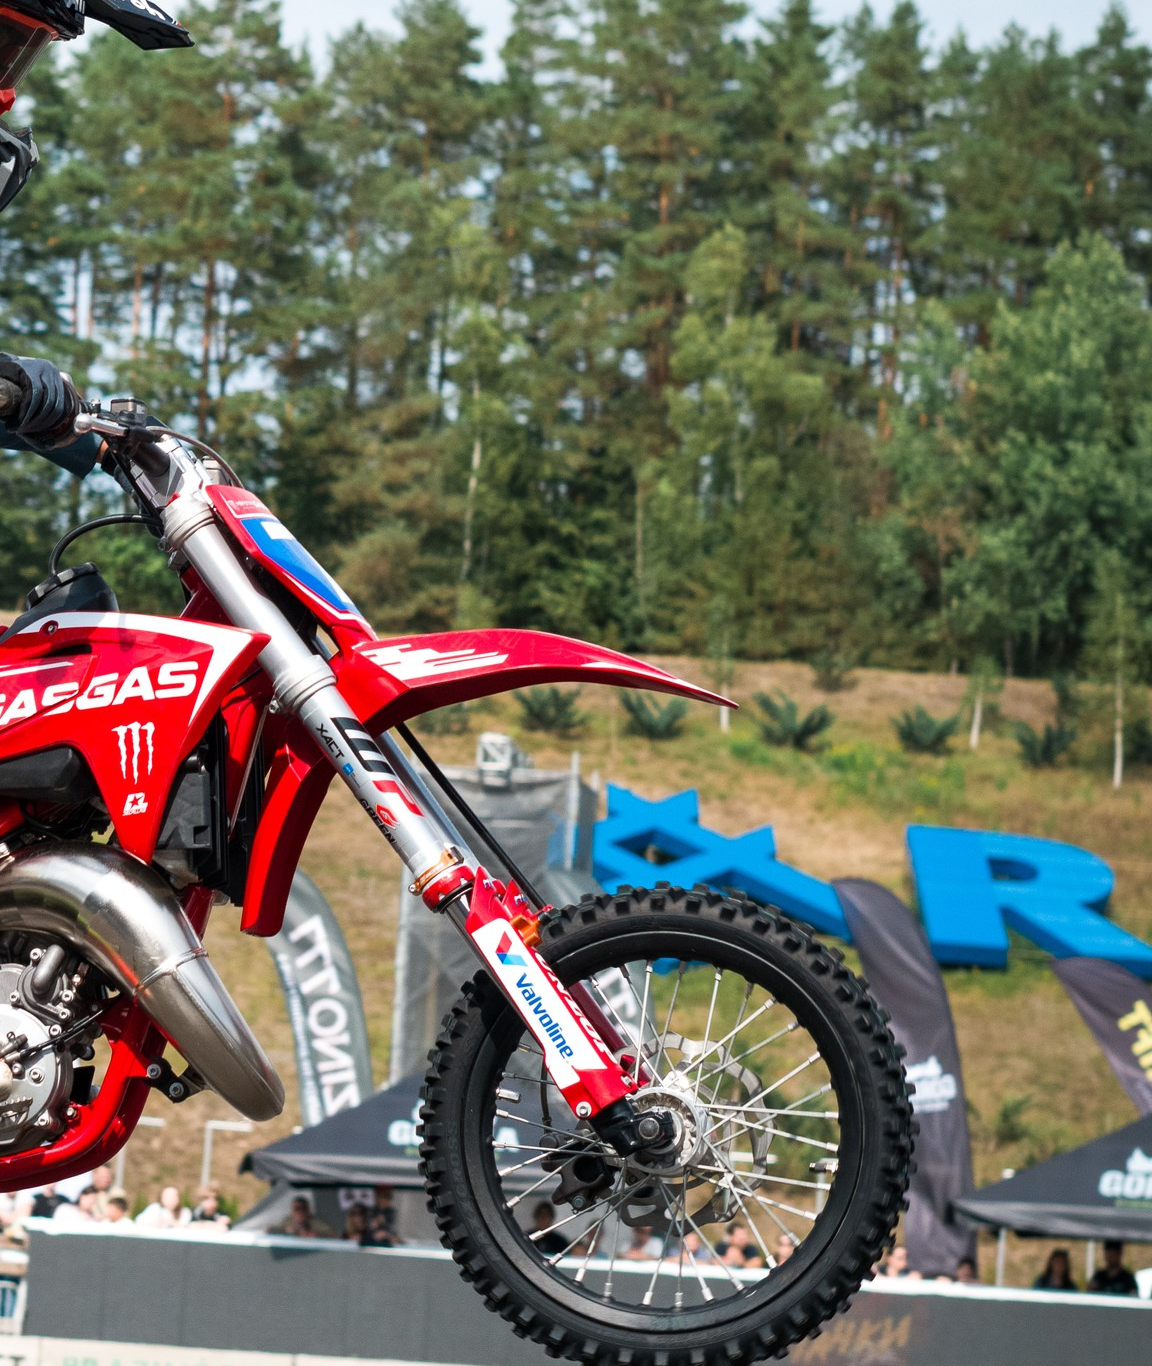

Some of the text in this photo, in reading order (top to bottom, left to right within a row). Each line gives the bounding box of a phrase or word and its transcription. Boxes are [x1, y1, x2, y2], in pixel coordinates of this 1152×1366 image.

[316, 722, 345, 759] XACT
[516, 972, 574, 1060] Valvoline
[535, 950, 618, 1065] UNLOP
